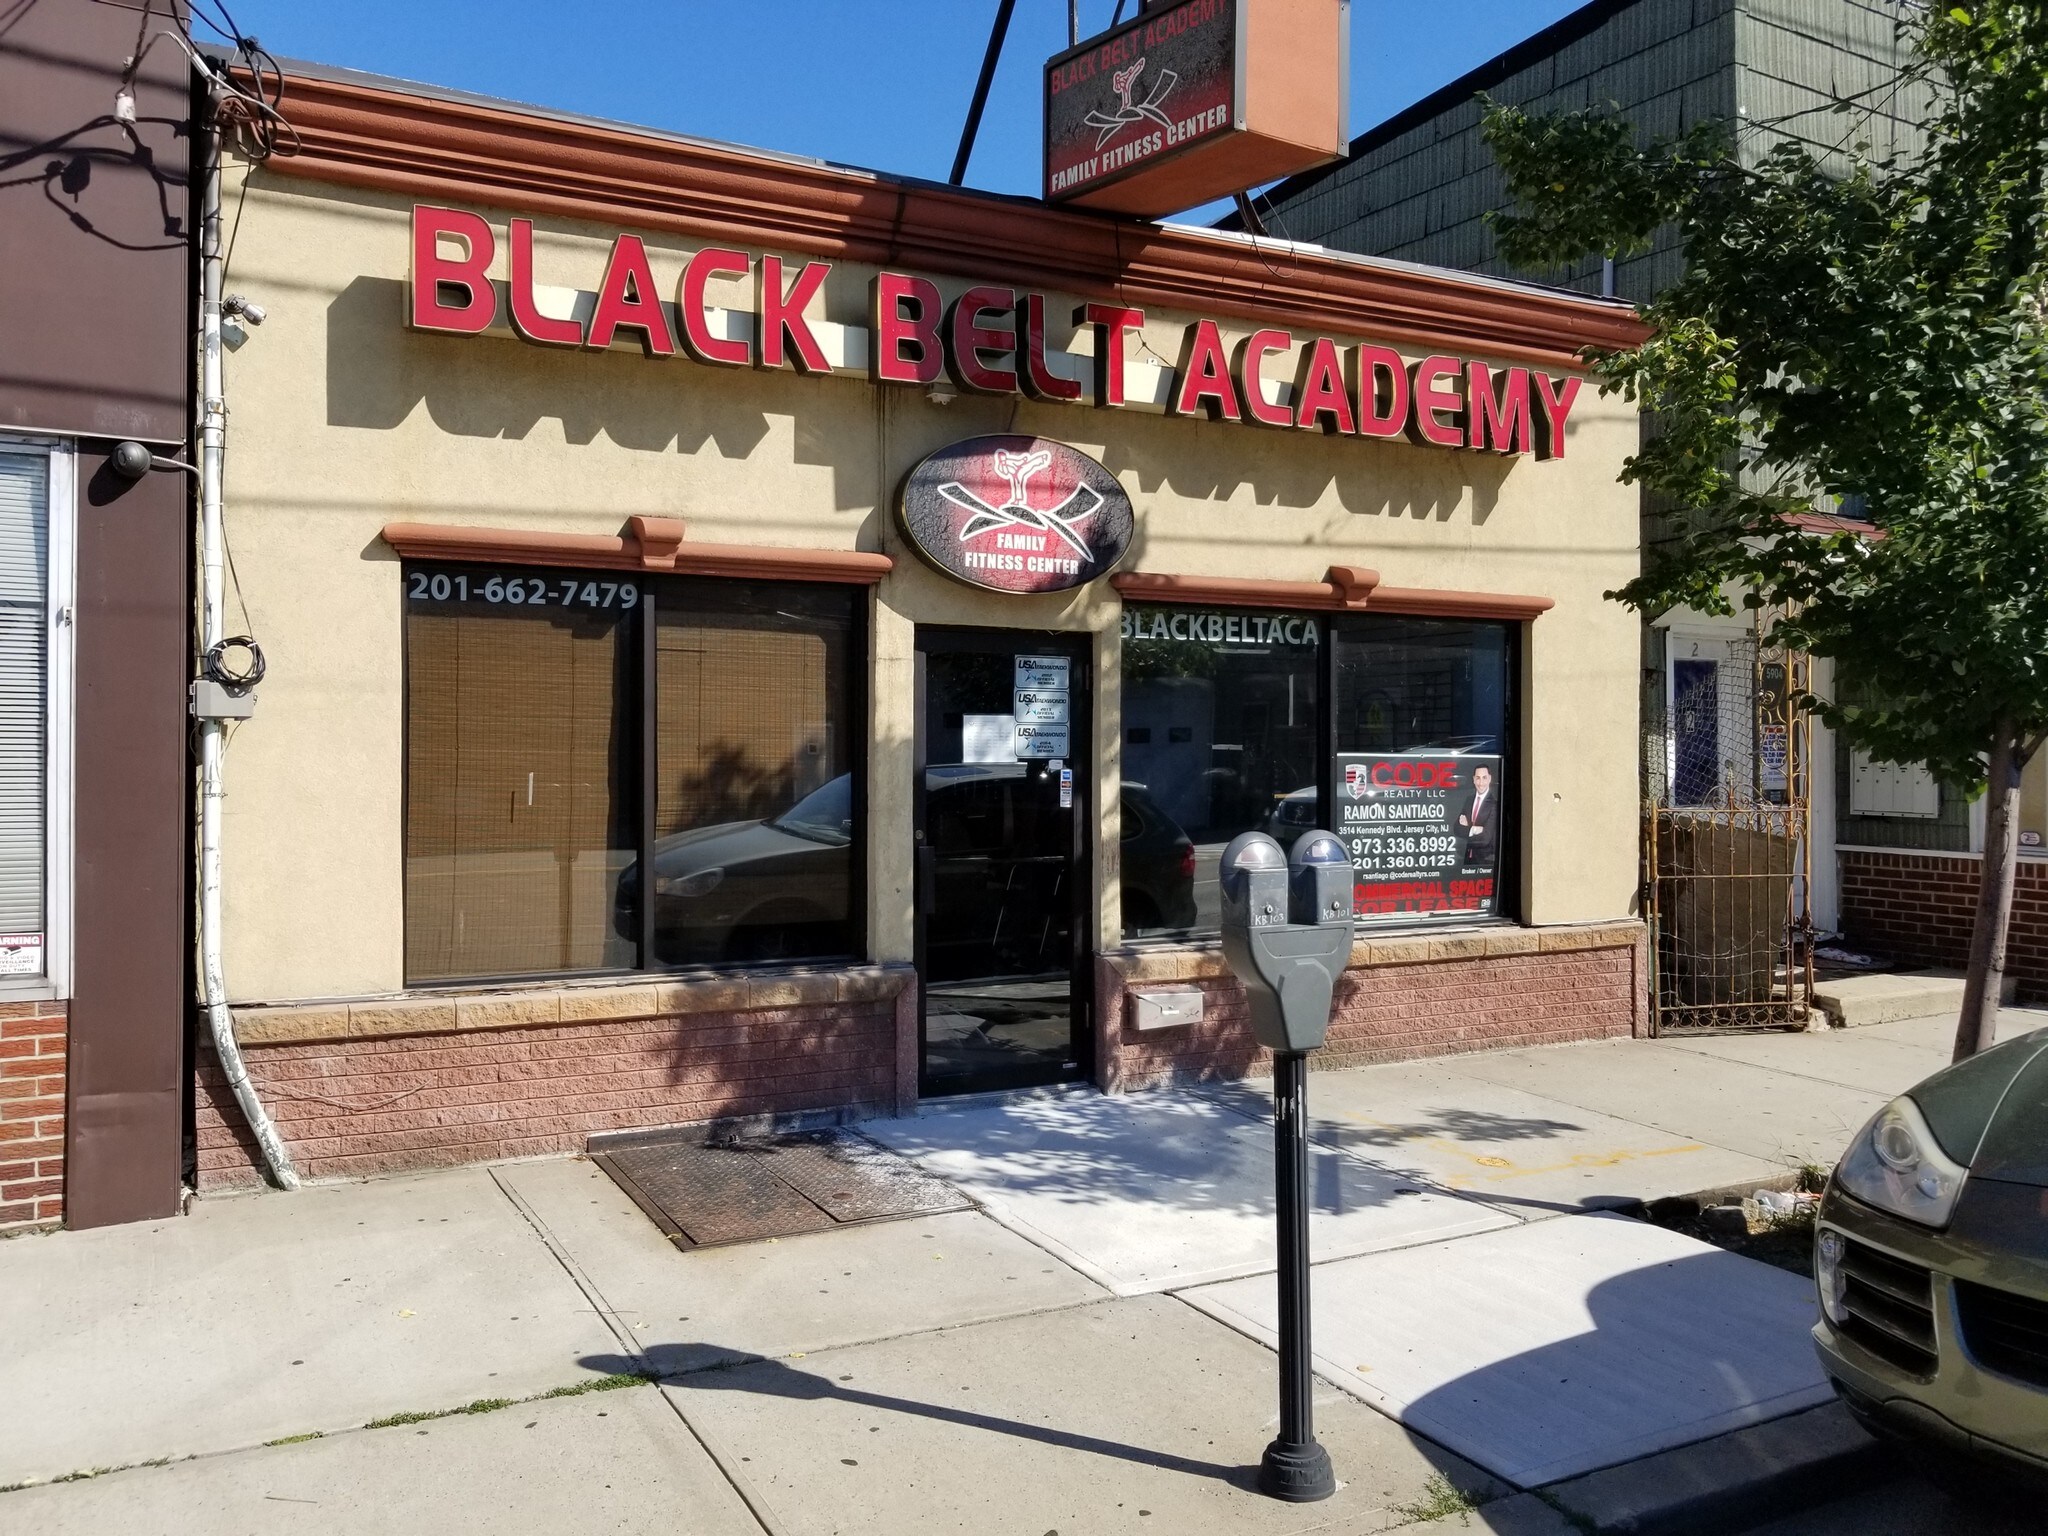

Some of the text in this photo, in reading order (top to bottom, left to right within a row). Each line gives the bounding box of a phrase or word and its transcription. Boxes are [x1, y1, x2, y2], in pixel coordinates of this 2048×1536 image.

[1051, 53, 1096, 95] BLACK
[1101, 30, 1140, 68] BELT
[1051, 103, 1227, 193] FAMILY FITNESS CENTER
[411, 203, 1583, 460] BLACK BELT ACADEMY
[996, 533, 1047, 551] FAMILY
[965, 552, 1079, 575] FITNESS CENTER
[409, 572, 638, 609] 201-662-7479
[1691, 642, 1698, 657] 2
[1018, 660, 1036, 669] USA
[1766, 667, 1783, 680] 5904
[1018, 693, 1036, 703] USA
[1018, 728, 1036, 737] USA
[1371, 761, 1458, 789] CODE
[1384, 789, 1446, 798] REALTY LLC
[1388, 804, 1445, 819] SANTIAGO
[1338, 824, 1449, 836] 3514 Kennedy Blvd. Jersey City, NJ
[1352, 836, 1456, 854] 973.336.8992
[1352, 855, 1456, 870] 201.360.0125
[1353, 879, 1494, 902] OMMERCIAL SPACE
[1255, 913, 1284, 926] KB 103
[1322, 908, 1350, 920] KB 101
